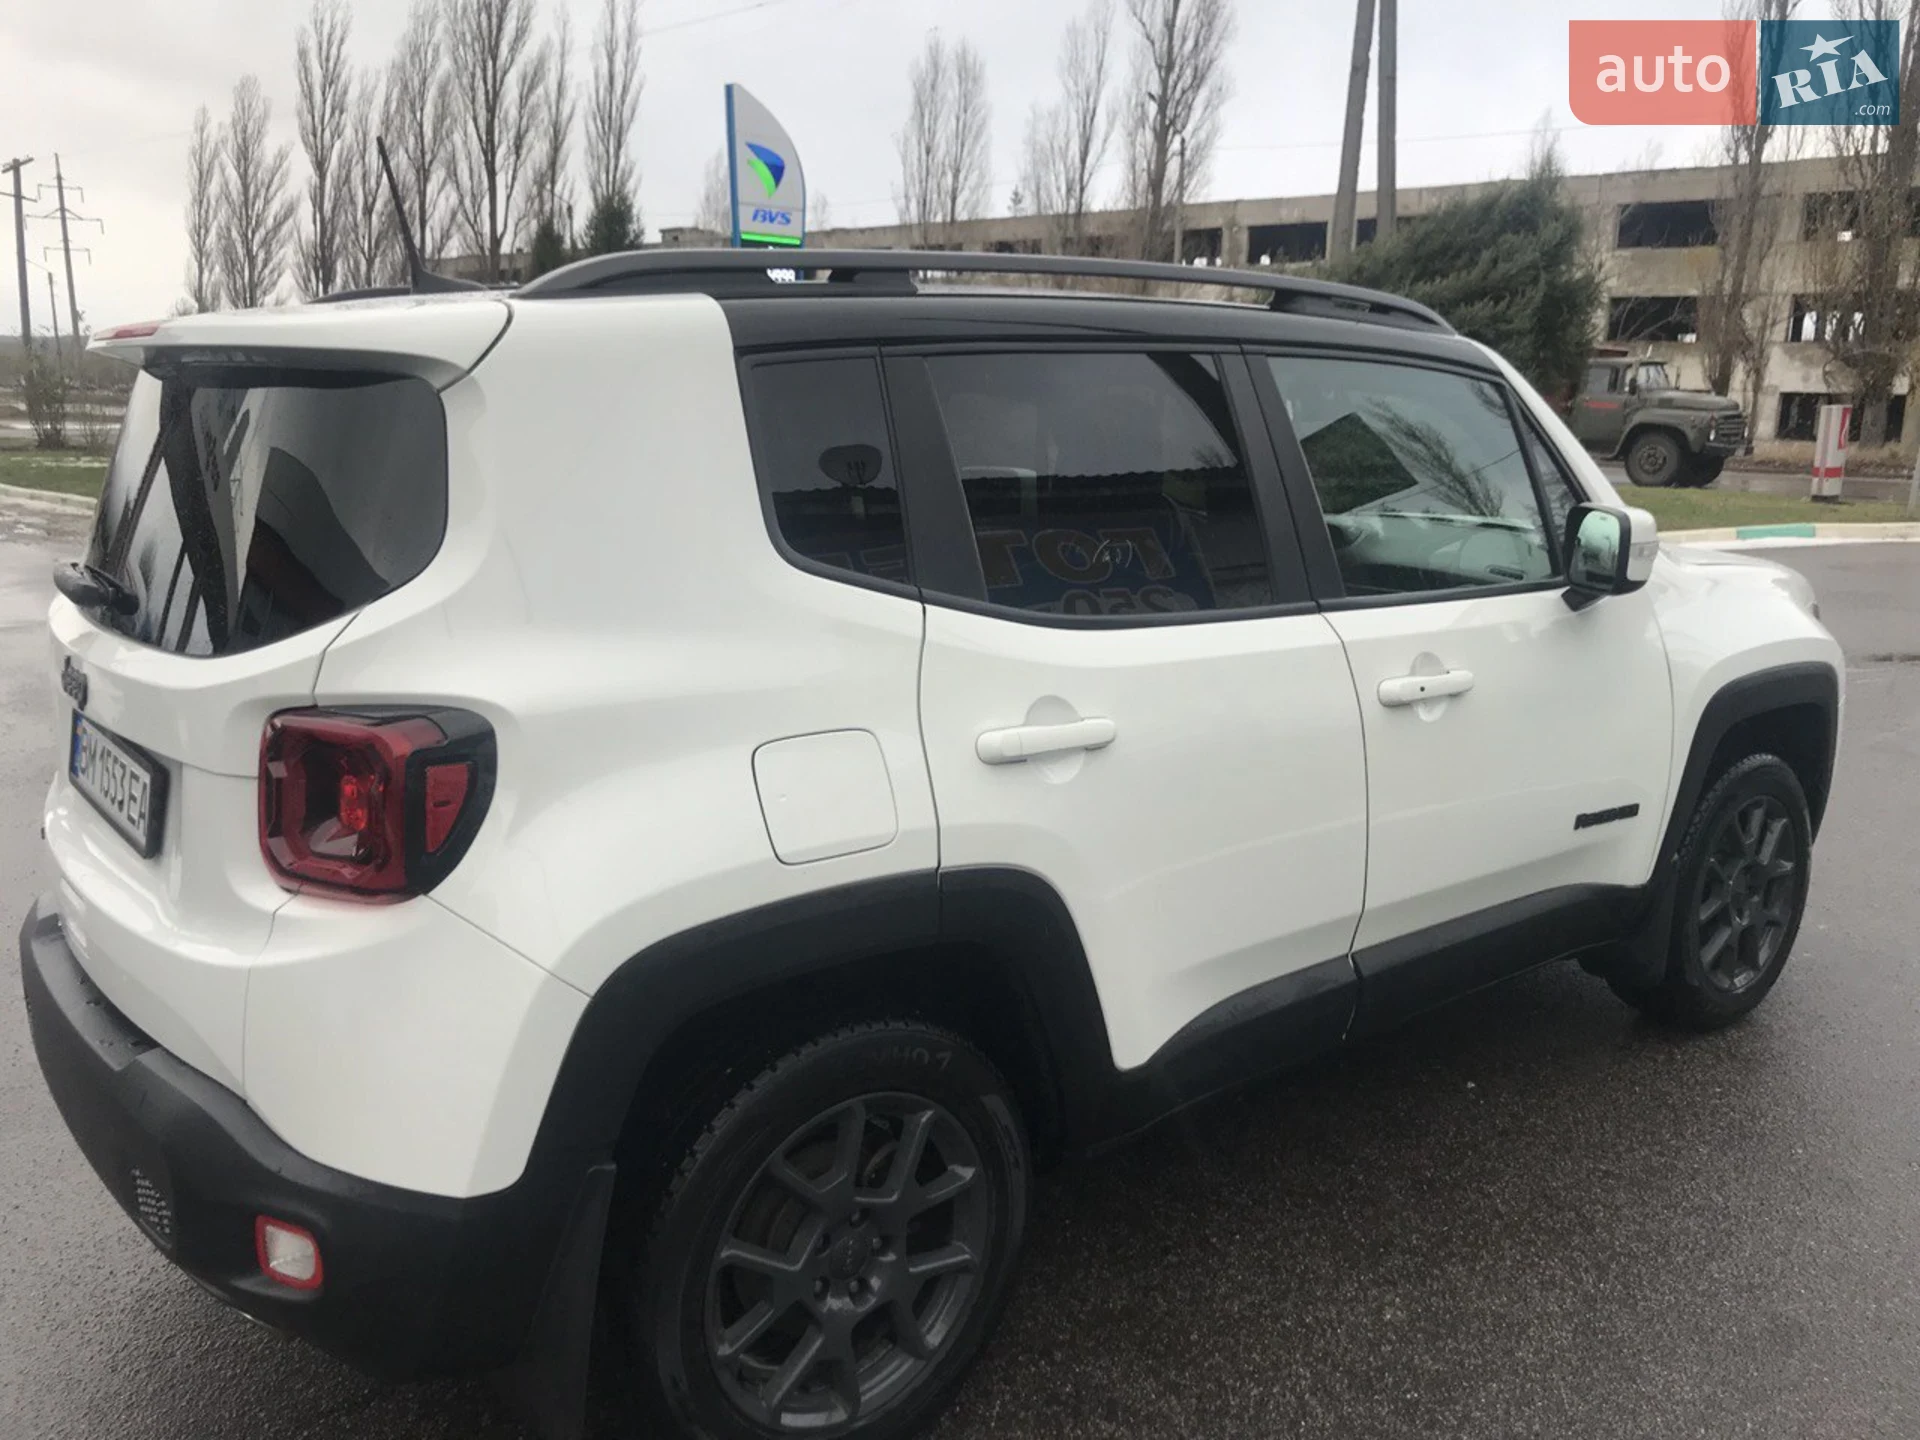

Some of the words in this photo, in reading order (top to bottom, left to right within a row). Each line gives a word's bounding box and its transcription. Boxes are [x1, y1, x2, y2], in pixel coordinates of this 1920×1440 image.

[752, 208, 791, 226] BVS
[99, 745, 127, 814] 1553
[127, 768, 148, 838] EA
